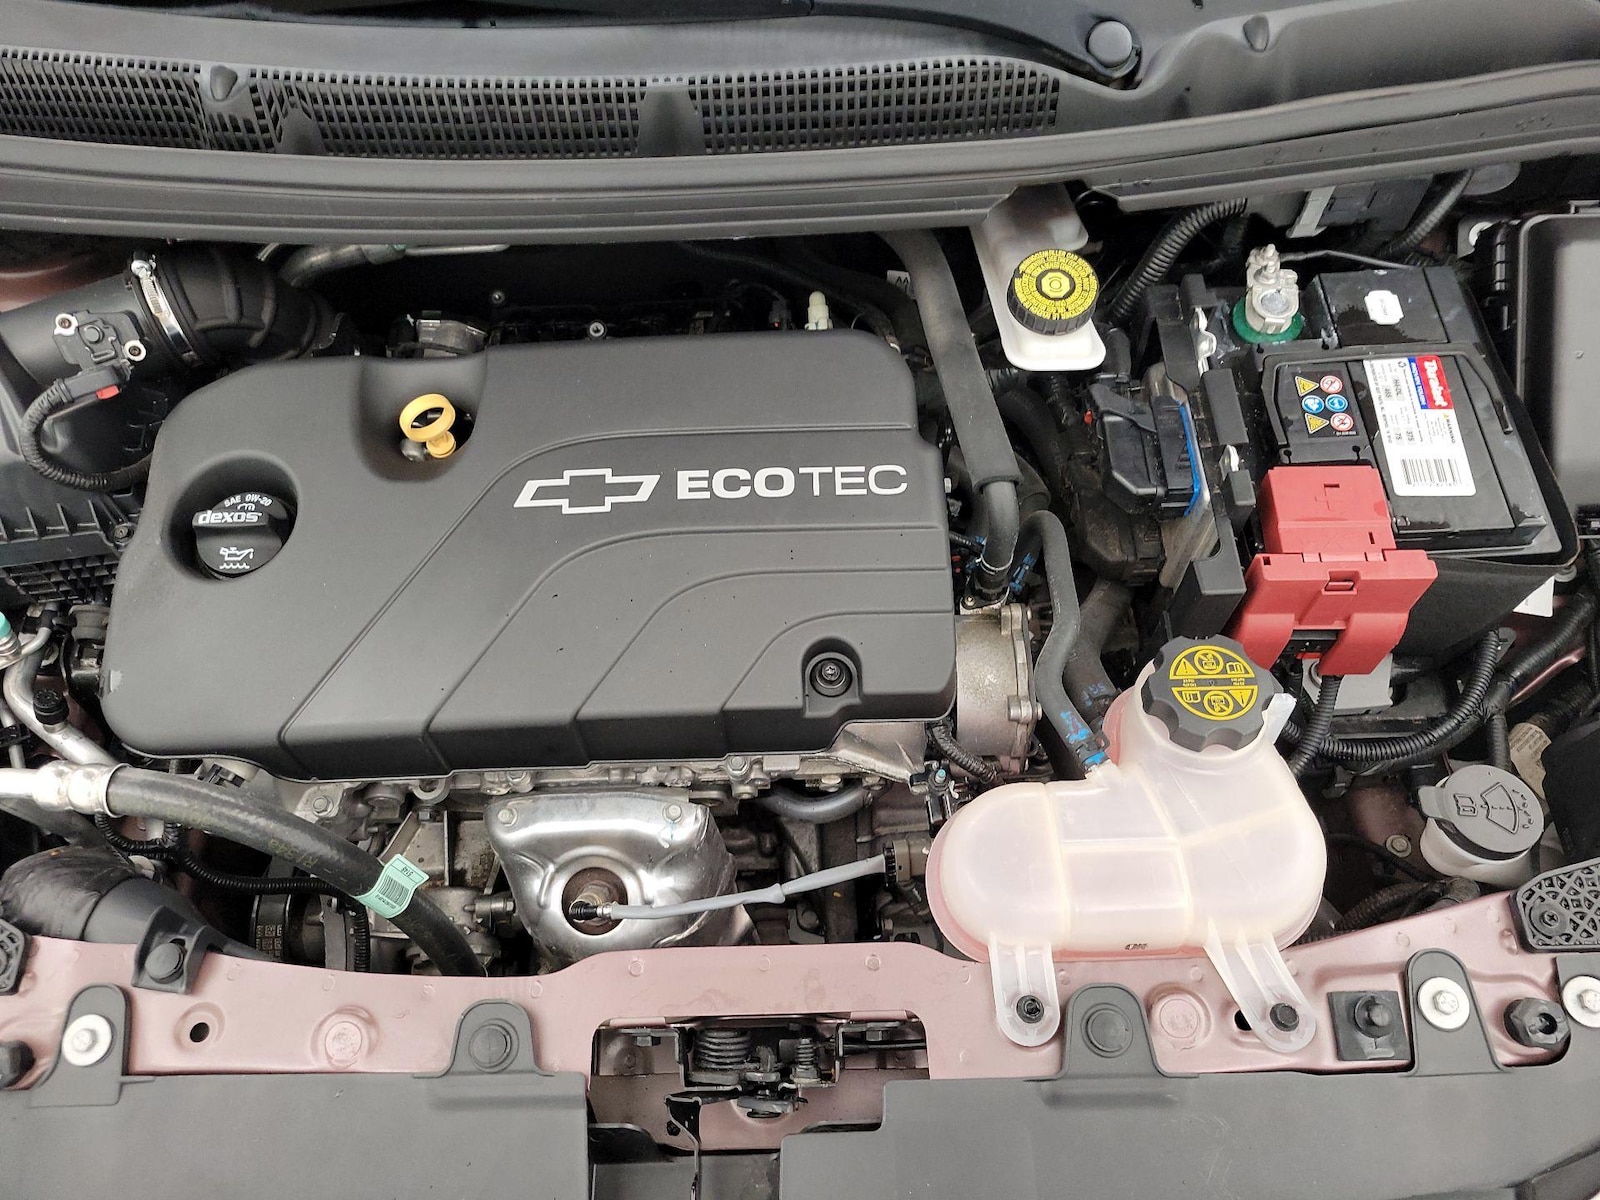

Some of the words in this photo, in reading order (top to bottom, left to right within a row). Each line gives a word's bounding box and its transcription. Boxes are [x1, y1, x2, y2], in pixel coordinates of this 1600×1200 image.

[1424, 359, 1448, 407] Duralast
[1446, 418, 1455, 444] WARNING
[676, 464, 909, 500] ECOTEC
[224, 495, 241, 507] SAE
[245, 493, 273, 507] 0W-20
[198, 509, 263, 525] dexos
